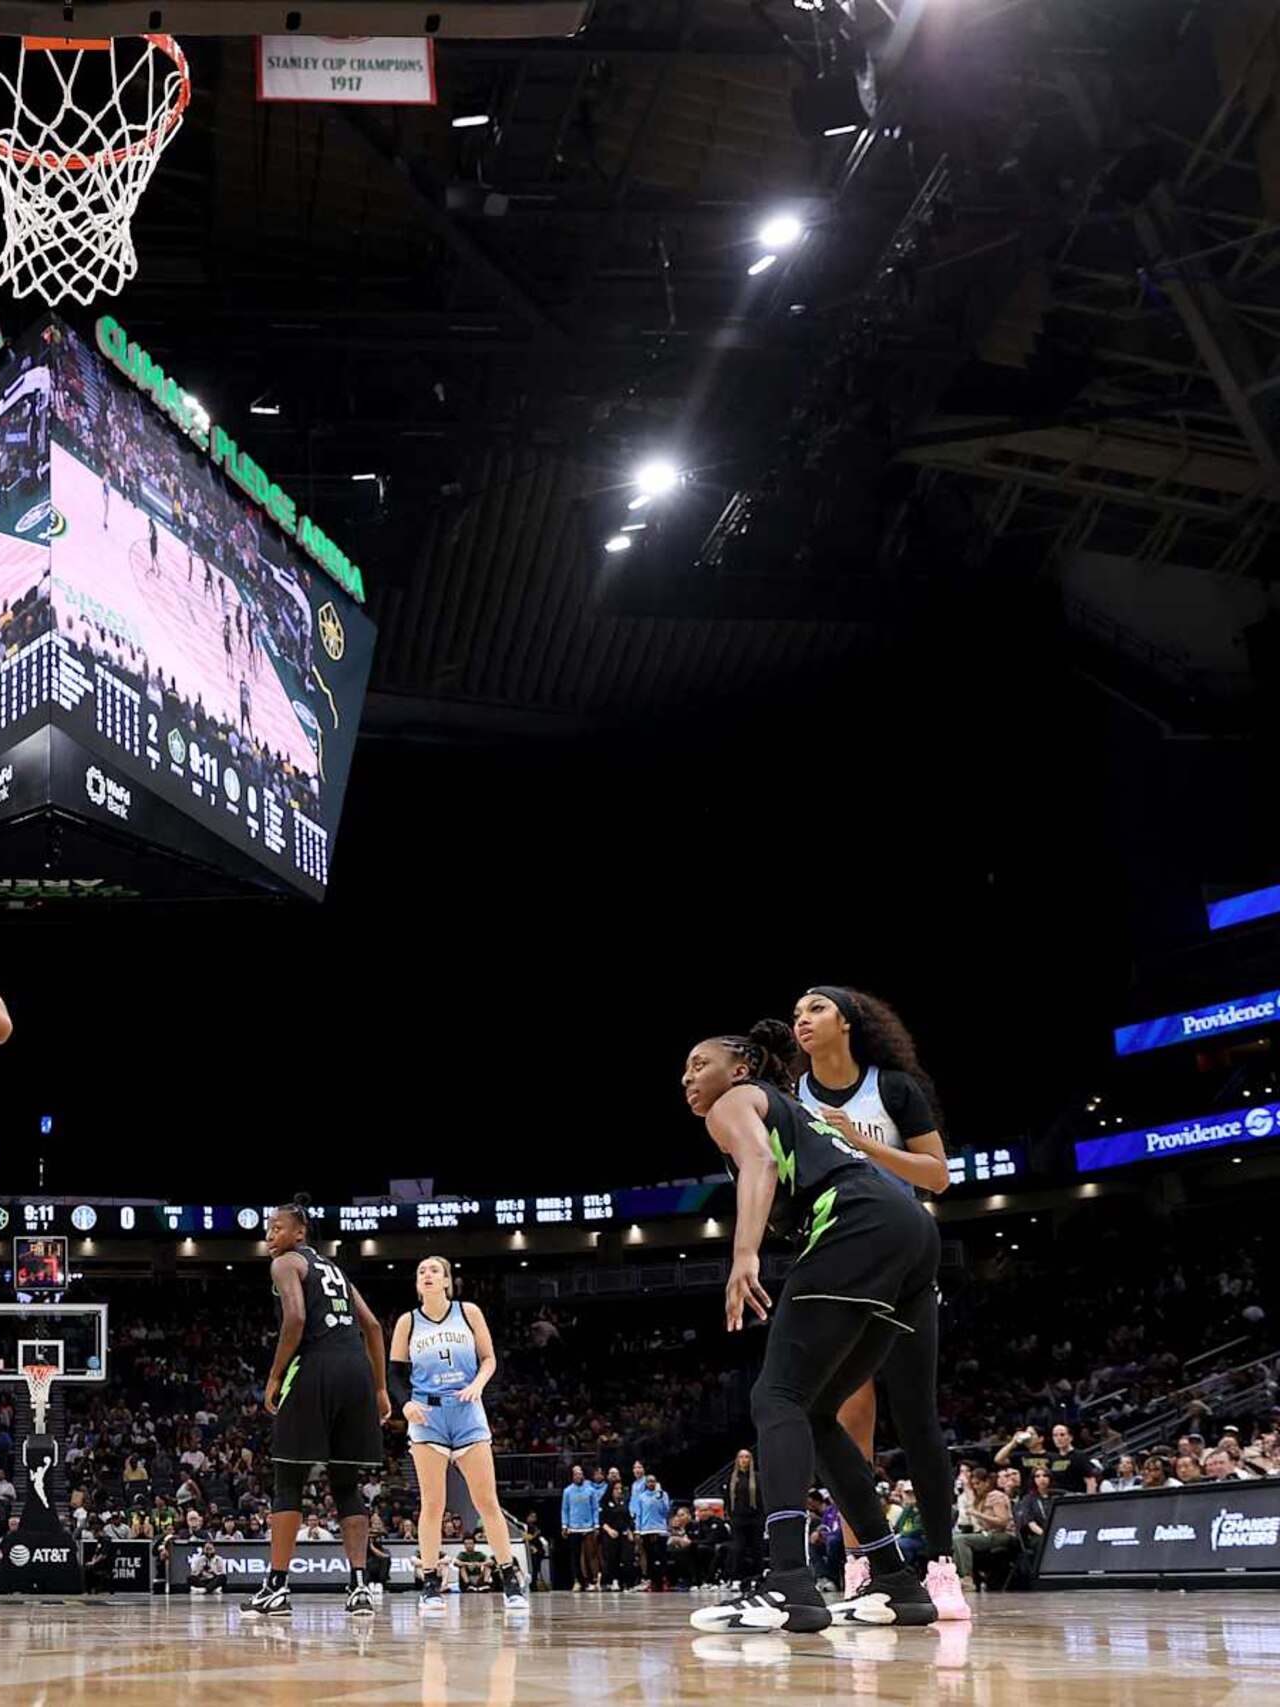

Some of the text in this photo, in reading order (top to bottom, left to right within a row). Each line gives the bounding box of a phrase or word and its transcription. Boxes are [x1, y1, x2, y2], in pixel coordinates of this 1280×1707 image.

[268, 56, 423, 72] STANLEY CUP CHAMPIONS
[331, 76, 362, 91] 1917
[211, 425, 297, 536] PLEDGE
[296, 515, 365, 603] ARENA
[147, 713, 158, 744] 2
[189, 742, 218, 787] 9:11
[106, 777, 131, 806] WaFd
[247, 786, 257, 813] 0
[1182, 1006, 1274, 1035] Providence
[1146, 1117, 1241, 1152] Providence
[24, 1205, 54, 1221] 9:11
[120, 1206, 135, 1230] 0
[203, 1216, 213, 1230] 5
[314, 1263, 348, 1299] 24
[439, 1348, 452, 1367] 4
[1218, 1531, 1278, 1546] MAKERS
[32, 1549, 69, 1563] AT&T
